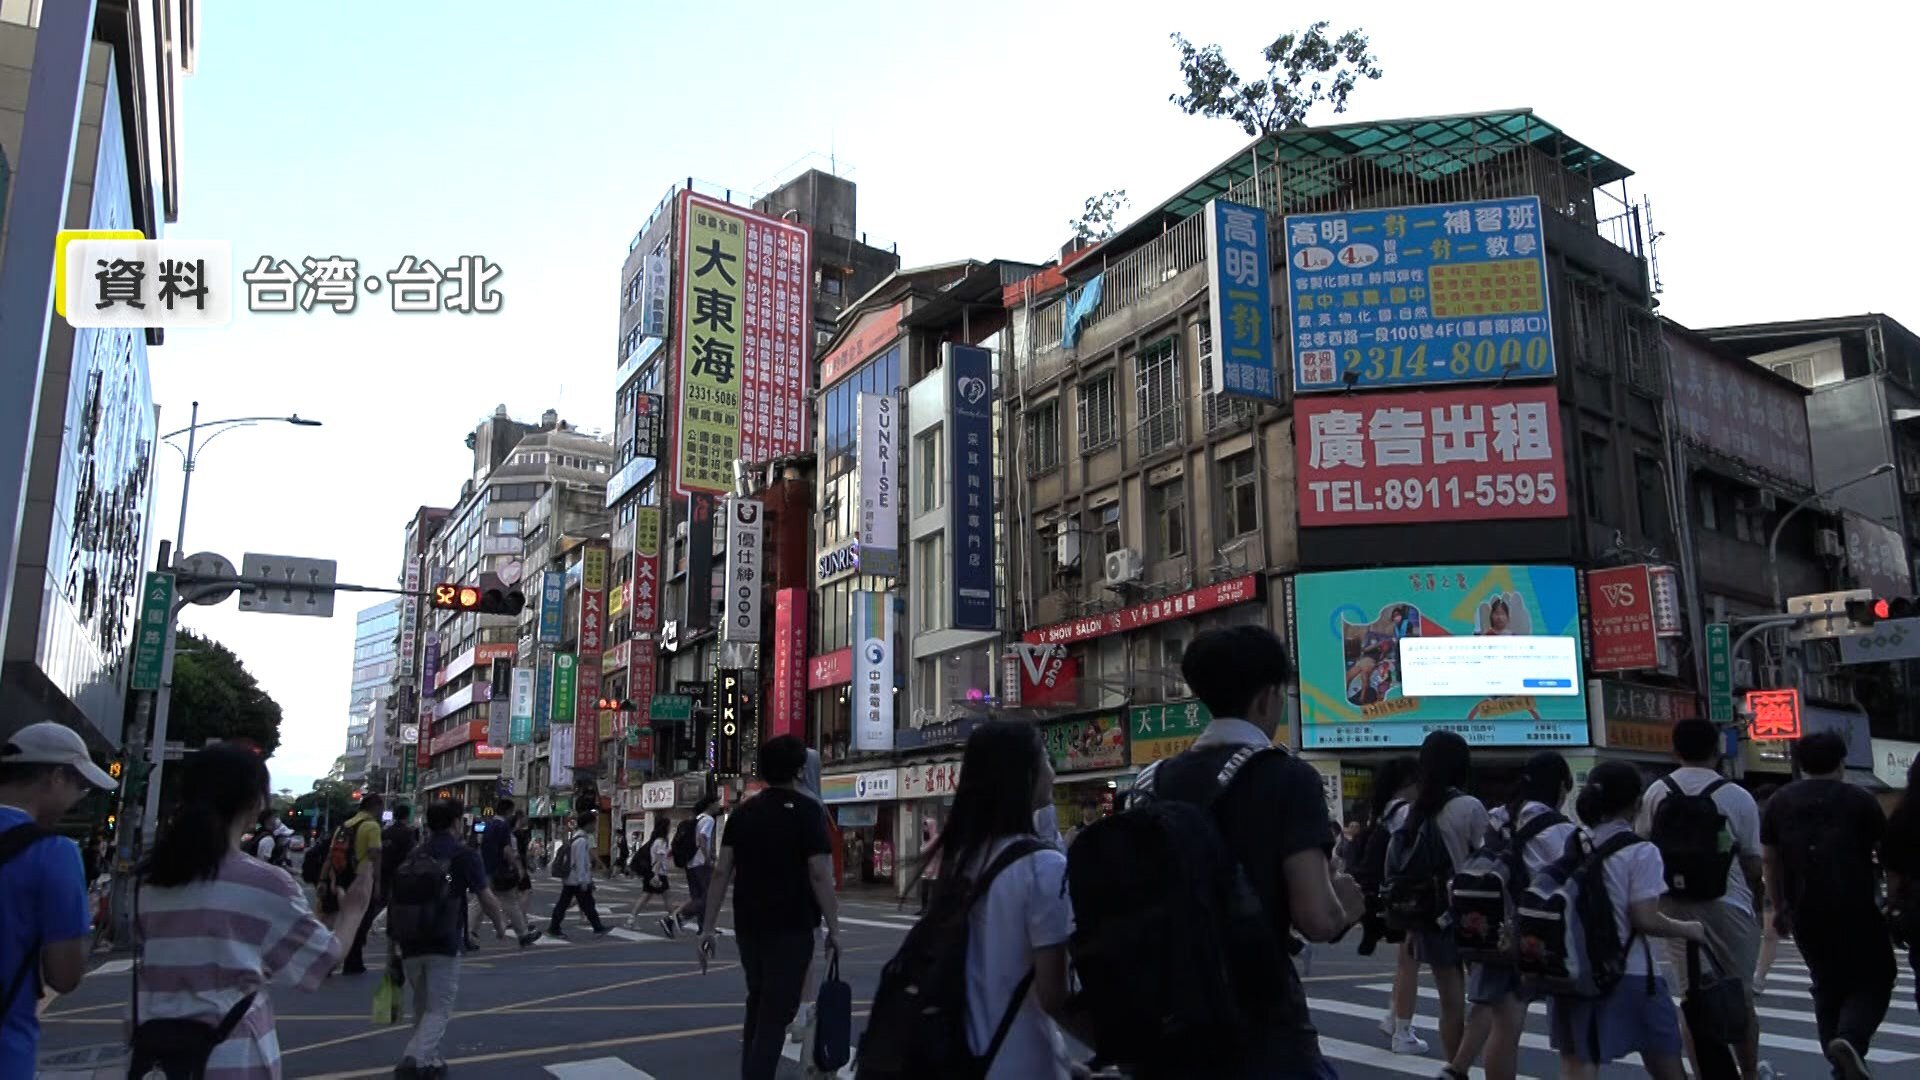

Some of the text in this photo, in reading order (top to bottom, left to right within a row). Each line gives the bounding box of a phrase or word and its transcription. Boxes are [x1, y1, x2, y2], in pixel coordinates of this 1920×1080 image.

[1291, 205, 1536, 247] 高明一對一補習班
[1222, 207, 1262, 359] 高明一對一
[690, 239, 737, 384] 大東海
[1343, 336, 1548, 381] 2314-8000
[689, 385, 737, 407] 2331-5086
[878, 398, 890, 508] SUNRISE
[1308, 402, 1553, 469] 廣告出租
[1308, 473, 1556, 512] TEL:8911-5595
[637, 561, 655, 620] 大東海
[1600, 583, 1634, 607] VS
[584, 595, 600, 648] 大東海
[1039, 619, 1101, 643] V SHOW SALON
[725, 677, 736, 736] PIKO
[1137, 702, 1200, 734] 天仁堂
